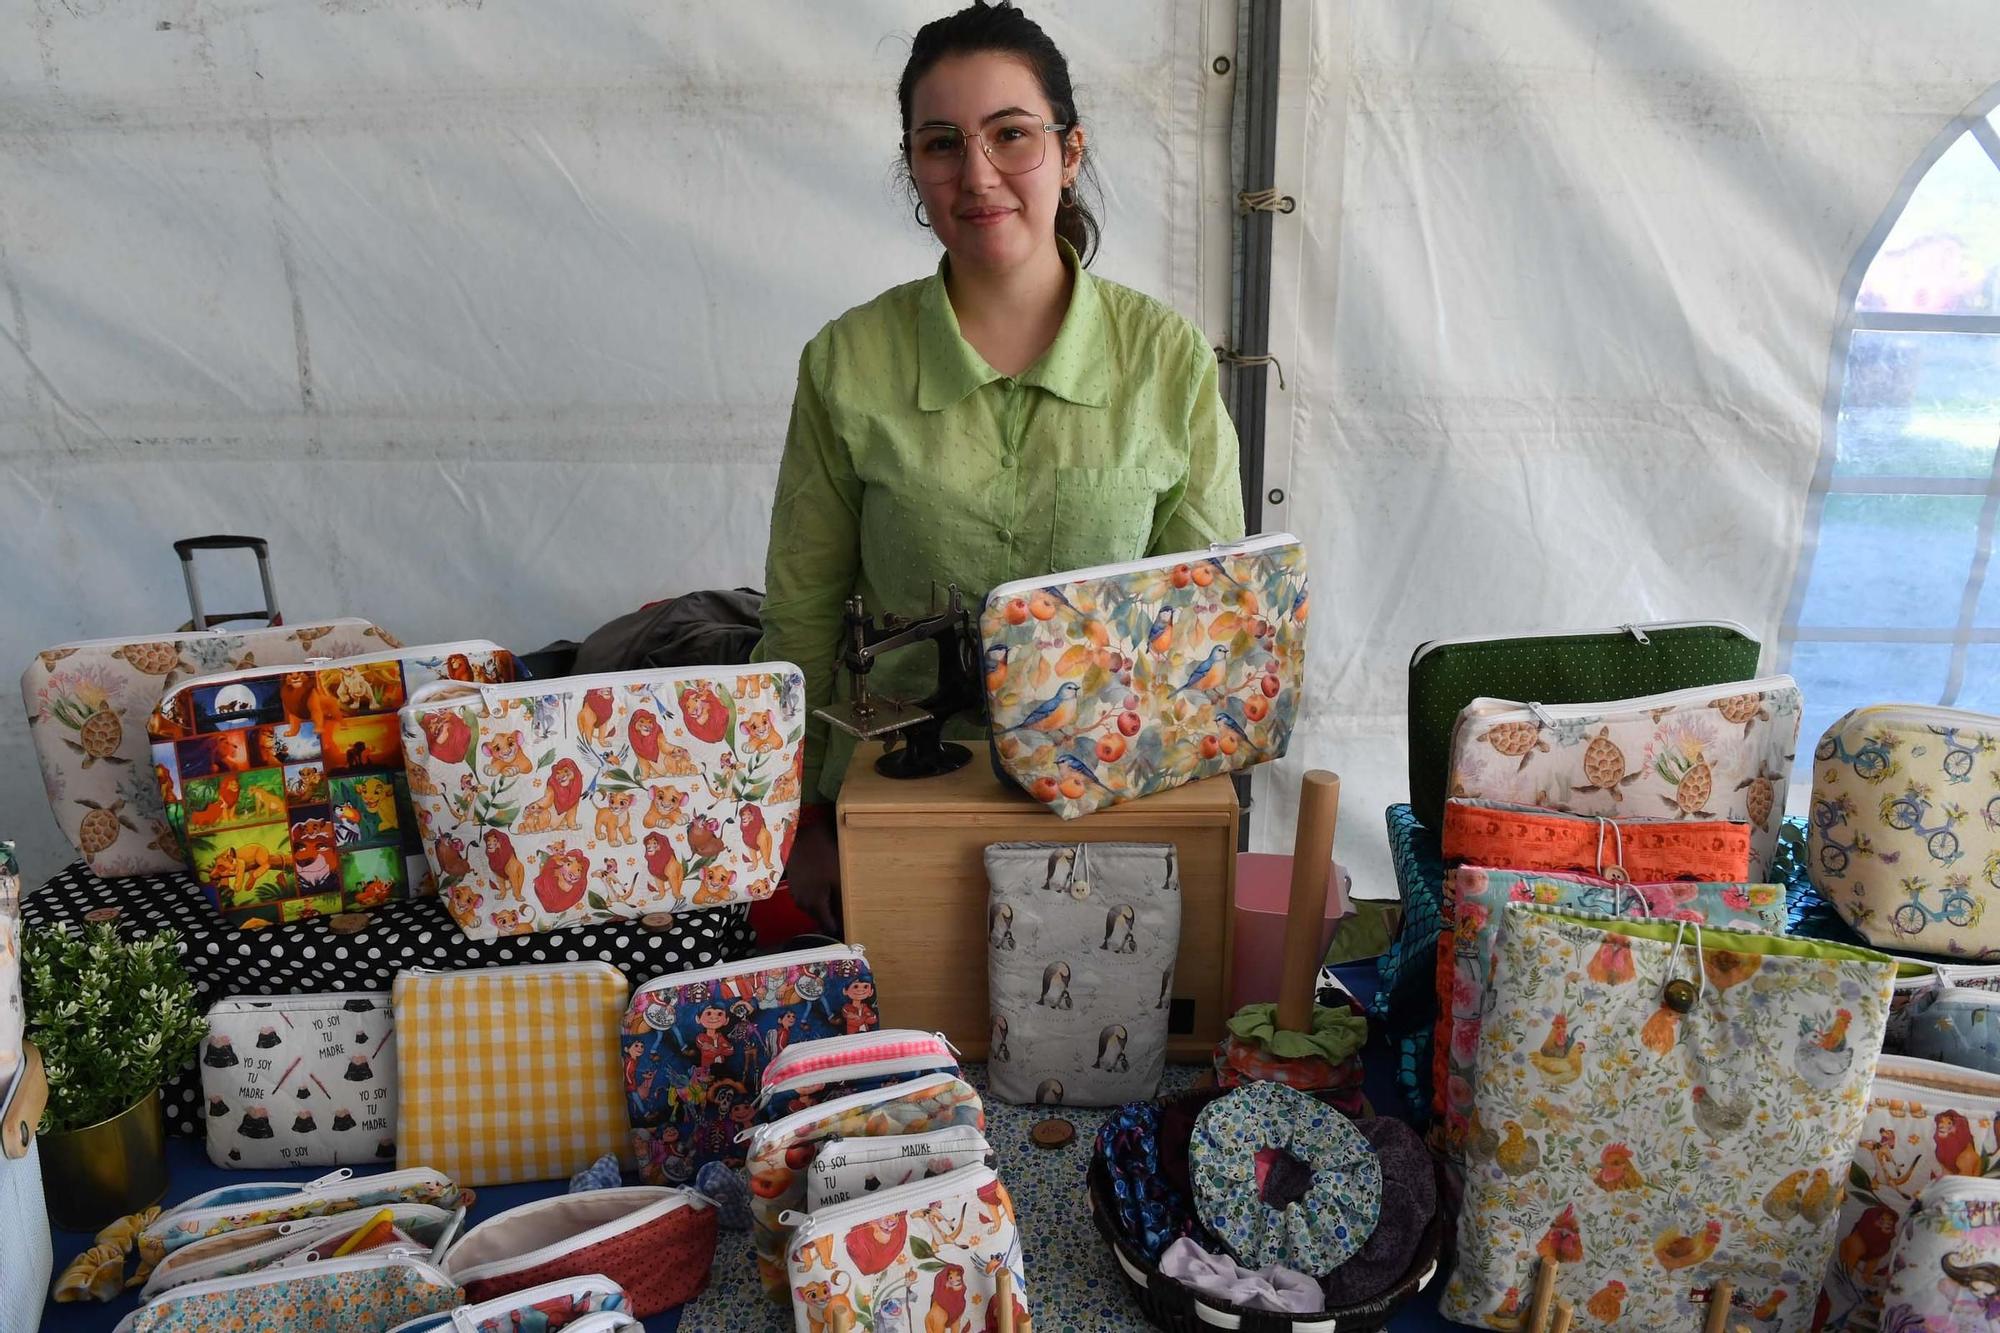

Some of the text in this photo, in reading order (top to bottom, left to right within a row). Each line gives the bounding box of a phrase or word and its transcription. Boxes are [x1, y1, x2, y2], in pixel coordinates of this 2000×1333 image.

[312, 1016, 341, 1030] YO SOY
[322, 1032, 333, 1042] TU
[319, 1044, 345, 1059] MADRE
[244, 1057, 272, 1070] YO SOY
[248, 1073, 258, 1083] TU
[239, 1087, 264, 1100] MADRE
[359, 1088, 387, 1101] YO SOY
[367, 1104, 377, 1114] TU
[362, 1117, 387, 1131] MADRE
[280, 1147, 309, 1158] YO SOY
[813, 1155, 847, 1173] YO SOY
[824, 1176, 836, 1189] TU
